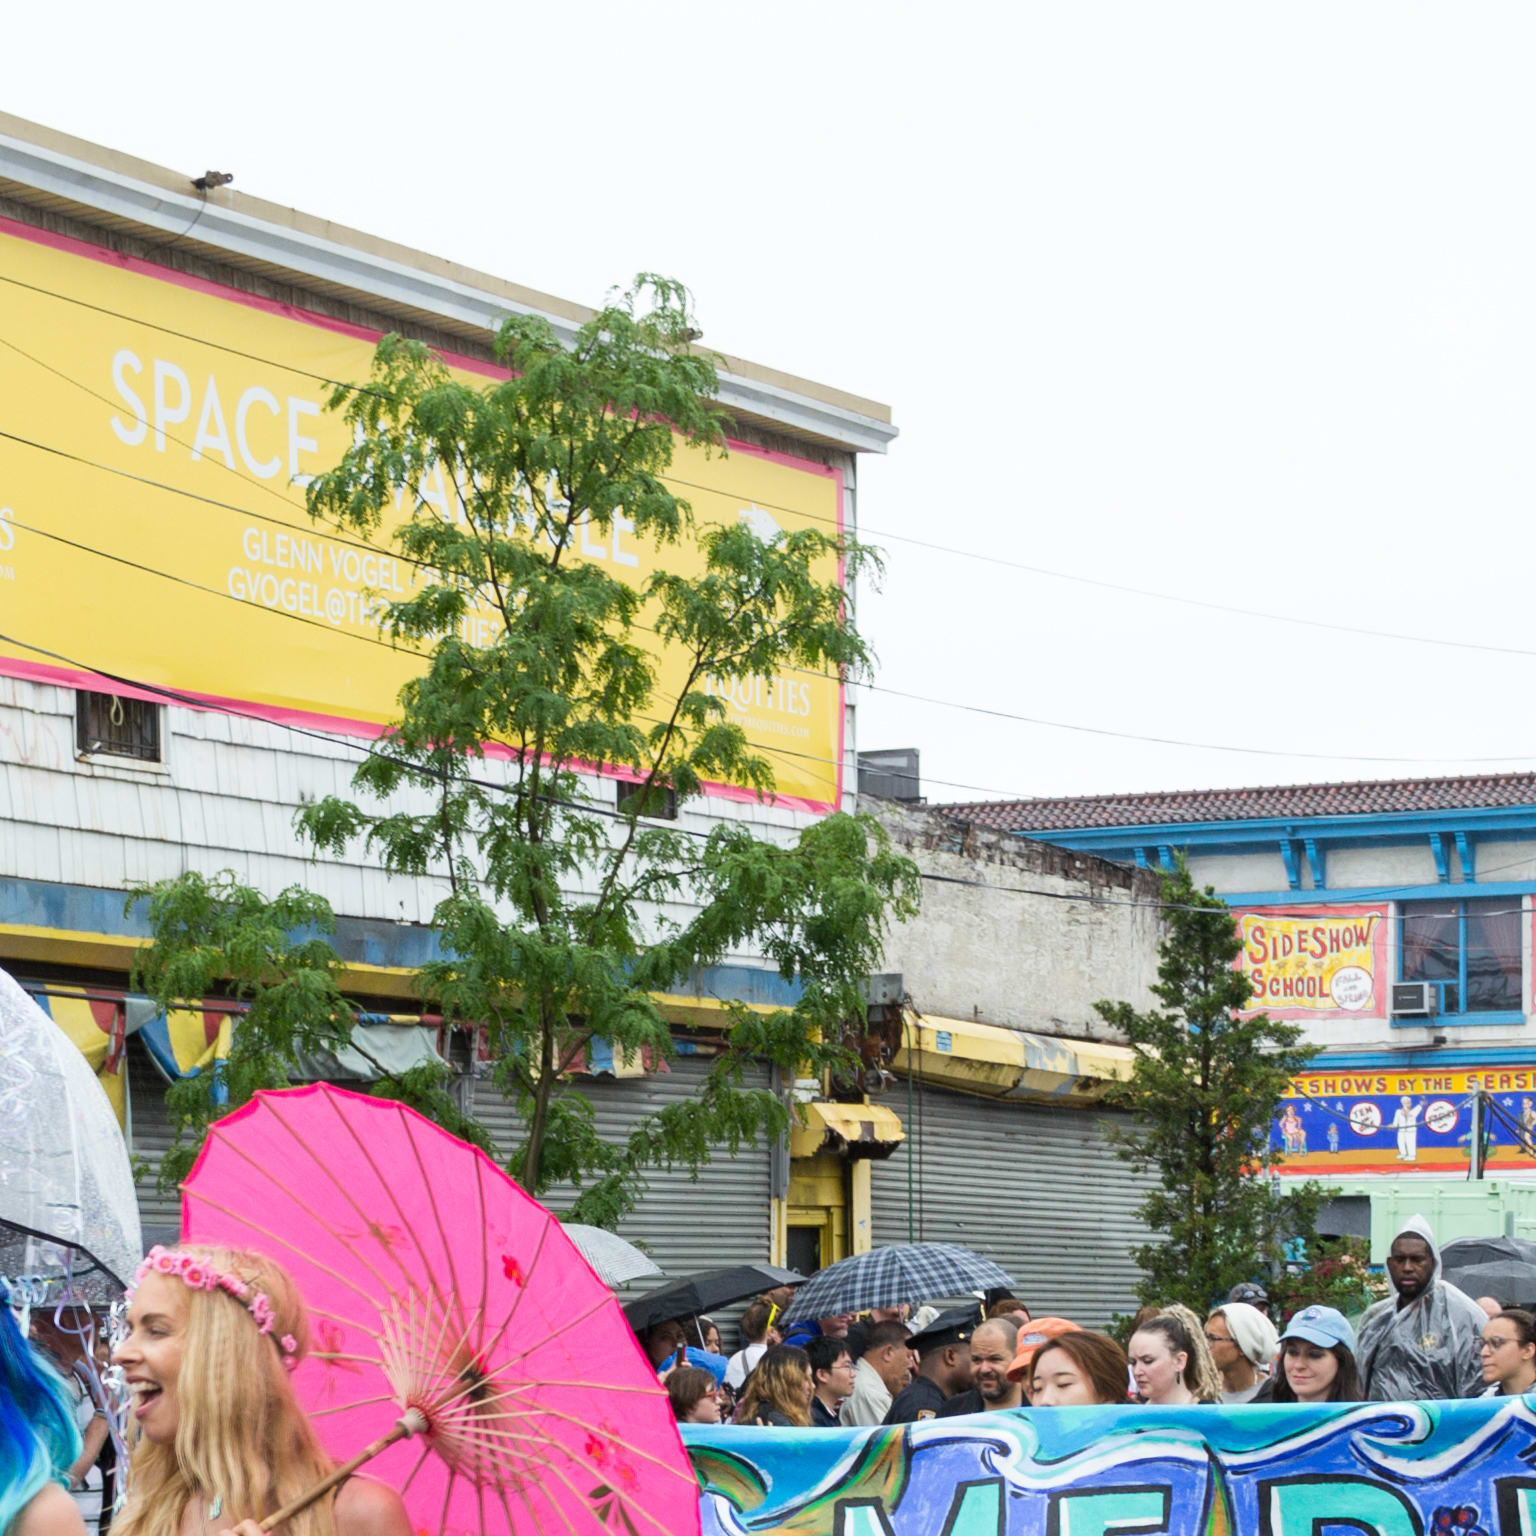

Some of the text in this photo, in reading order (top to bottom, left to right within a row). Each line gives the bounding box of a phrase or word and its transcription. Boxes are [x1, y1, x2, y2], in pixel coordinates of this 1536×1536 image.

[109, 348, 321, 489] SPACE
[242, 527, 323, 574] GLENN
[330, 548, 404, 594] VOGEL
[1248, 916, 1374, 965] SIDESHOW
[1251, 968, 1330, 998] SCHOOL
[1398, 1078, 1419, 1092] BY
[1423, 1076, 1453, 1091] THE
